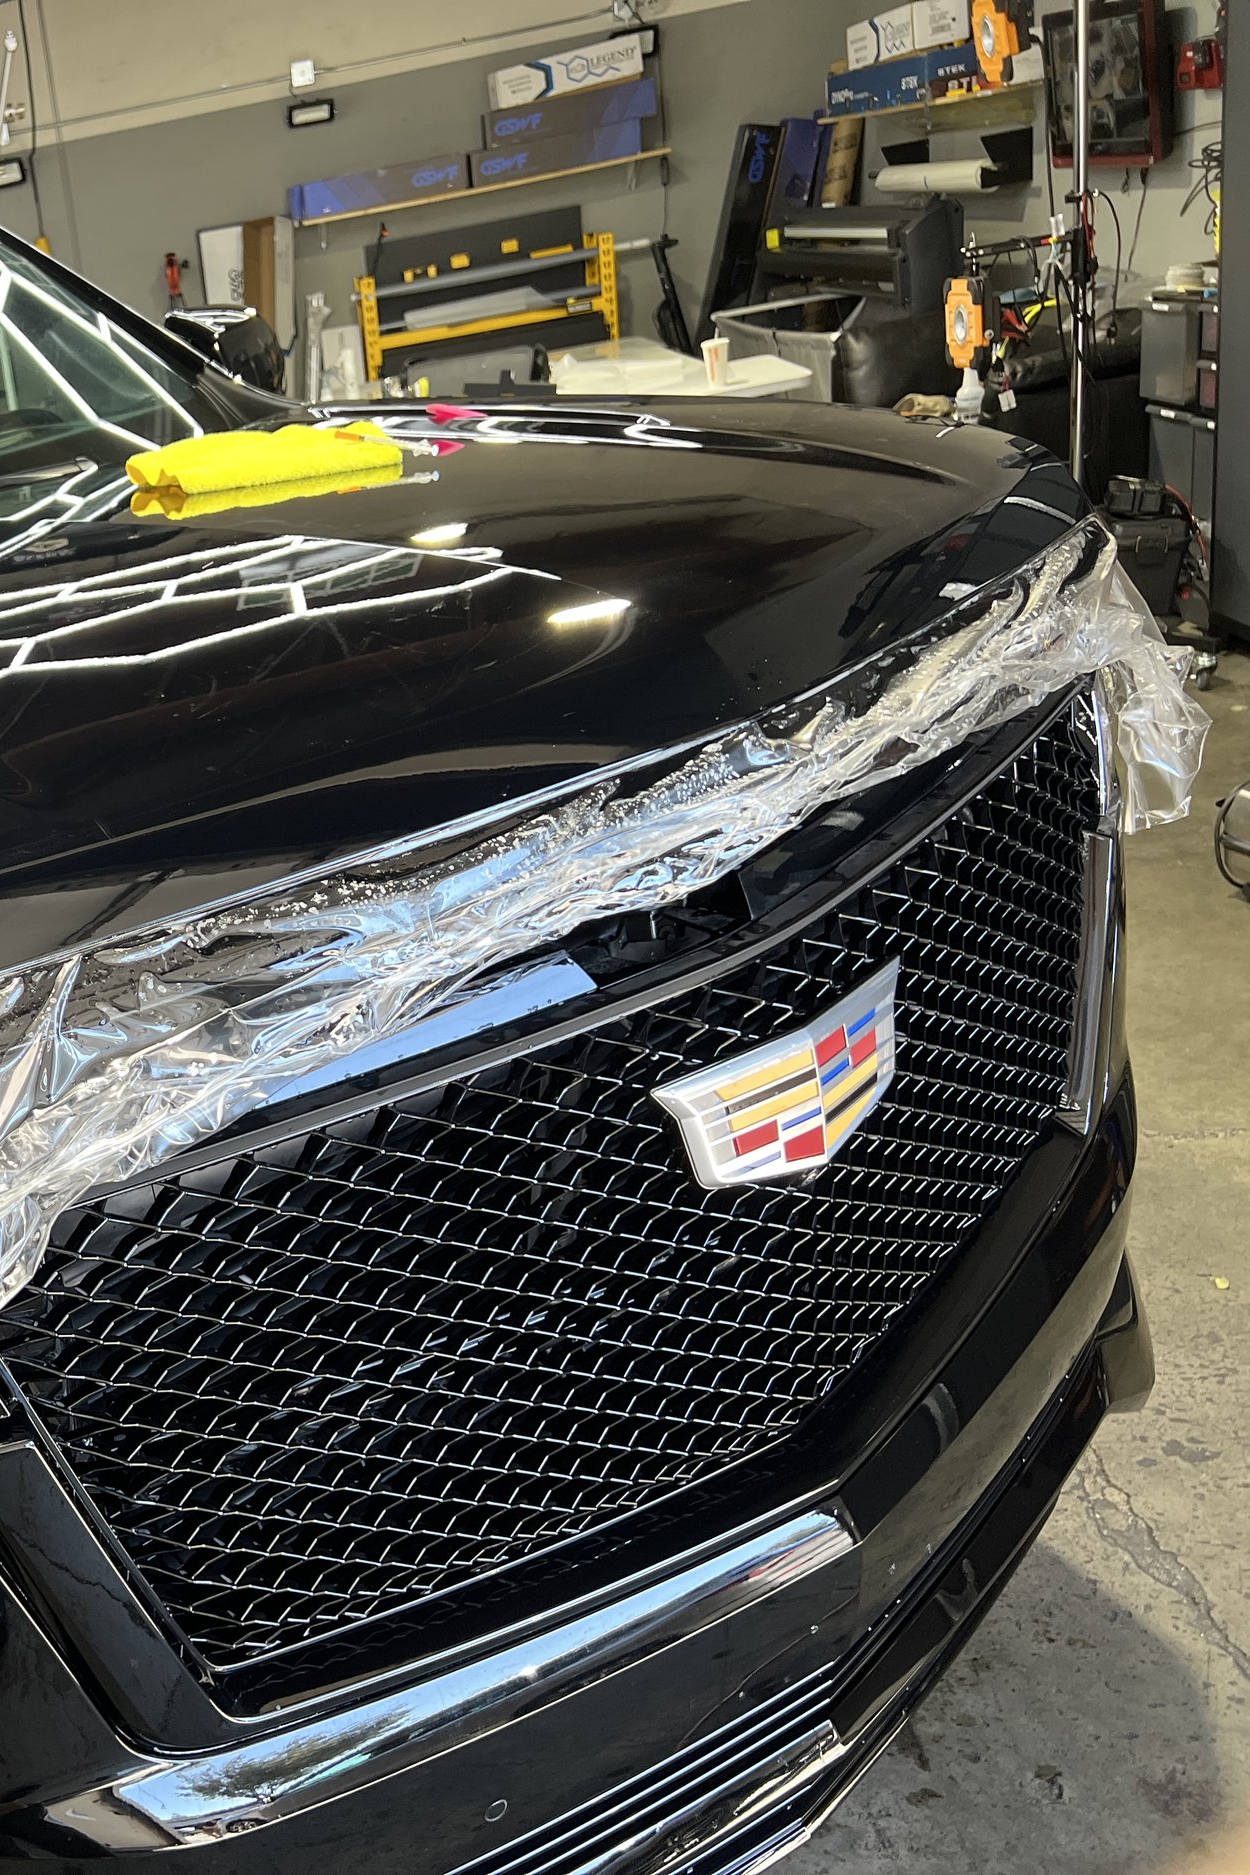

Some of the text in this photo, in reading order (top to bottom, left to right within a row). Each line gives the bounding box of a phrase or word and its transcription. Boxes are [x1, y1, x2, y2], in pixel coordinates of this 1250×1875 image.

[589, 48, 635, 66] LEGEND
[937, 64, 966, 77] STEK
[494, 112, 542, 136] GSWF
[480, 152, 527, 176] GSWF
